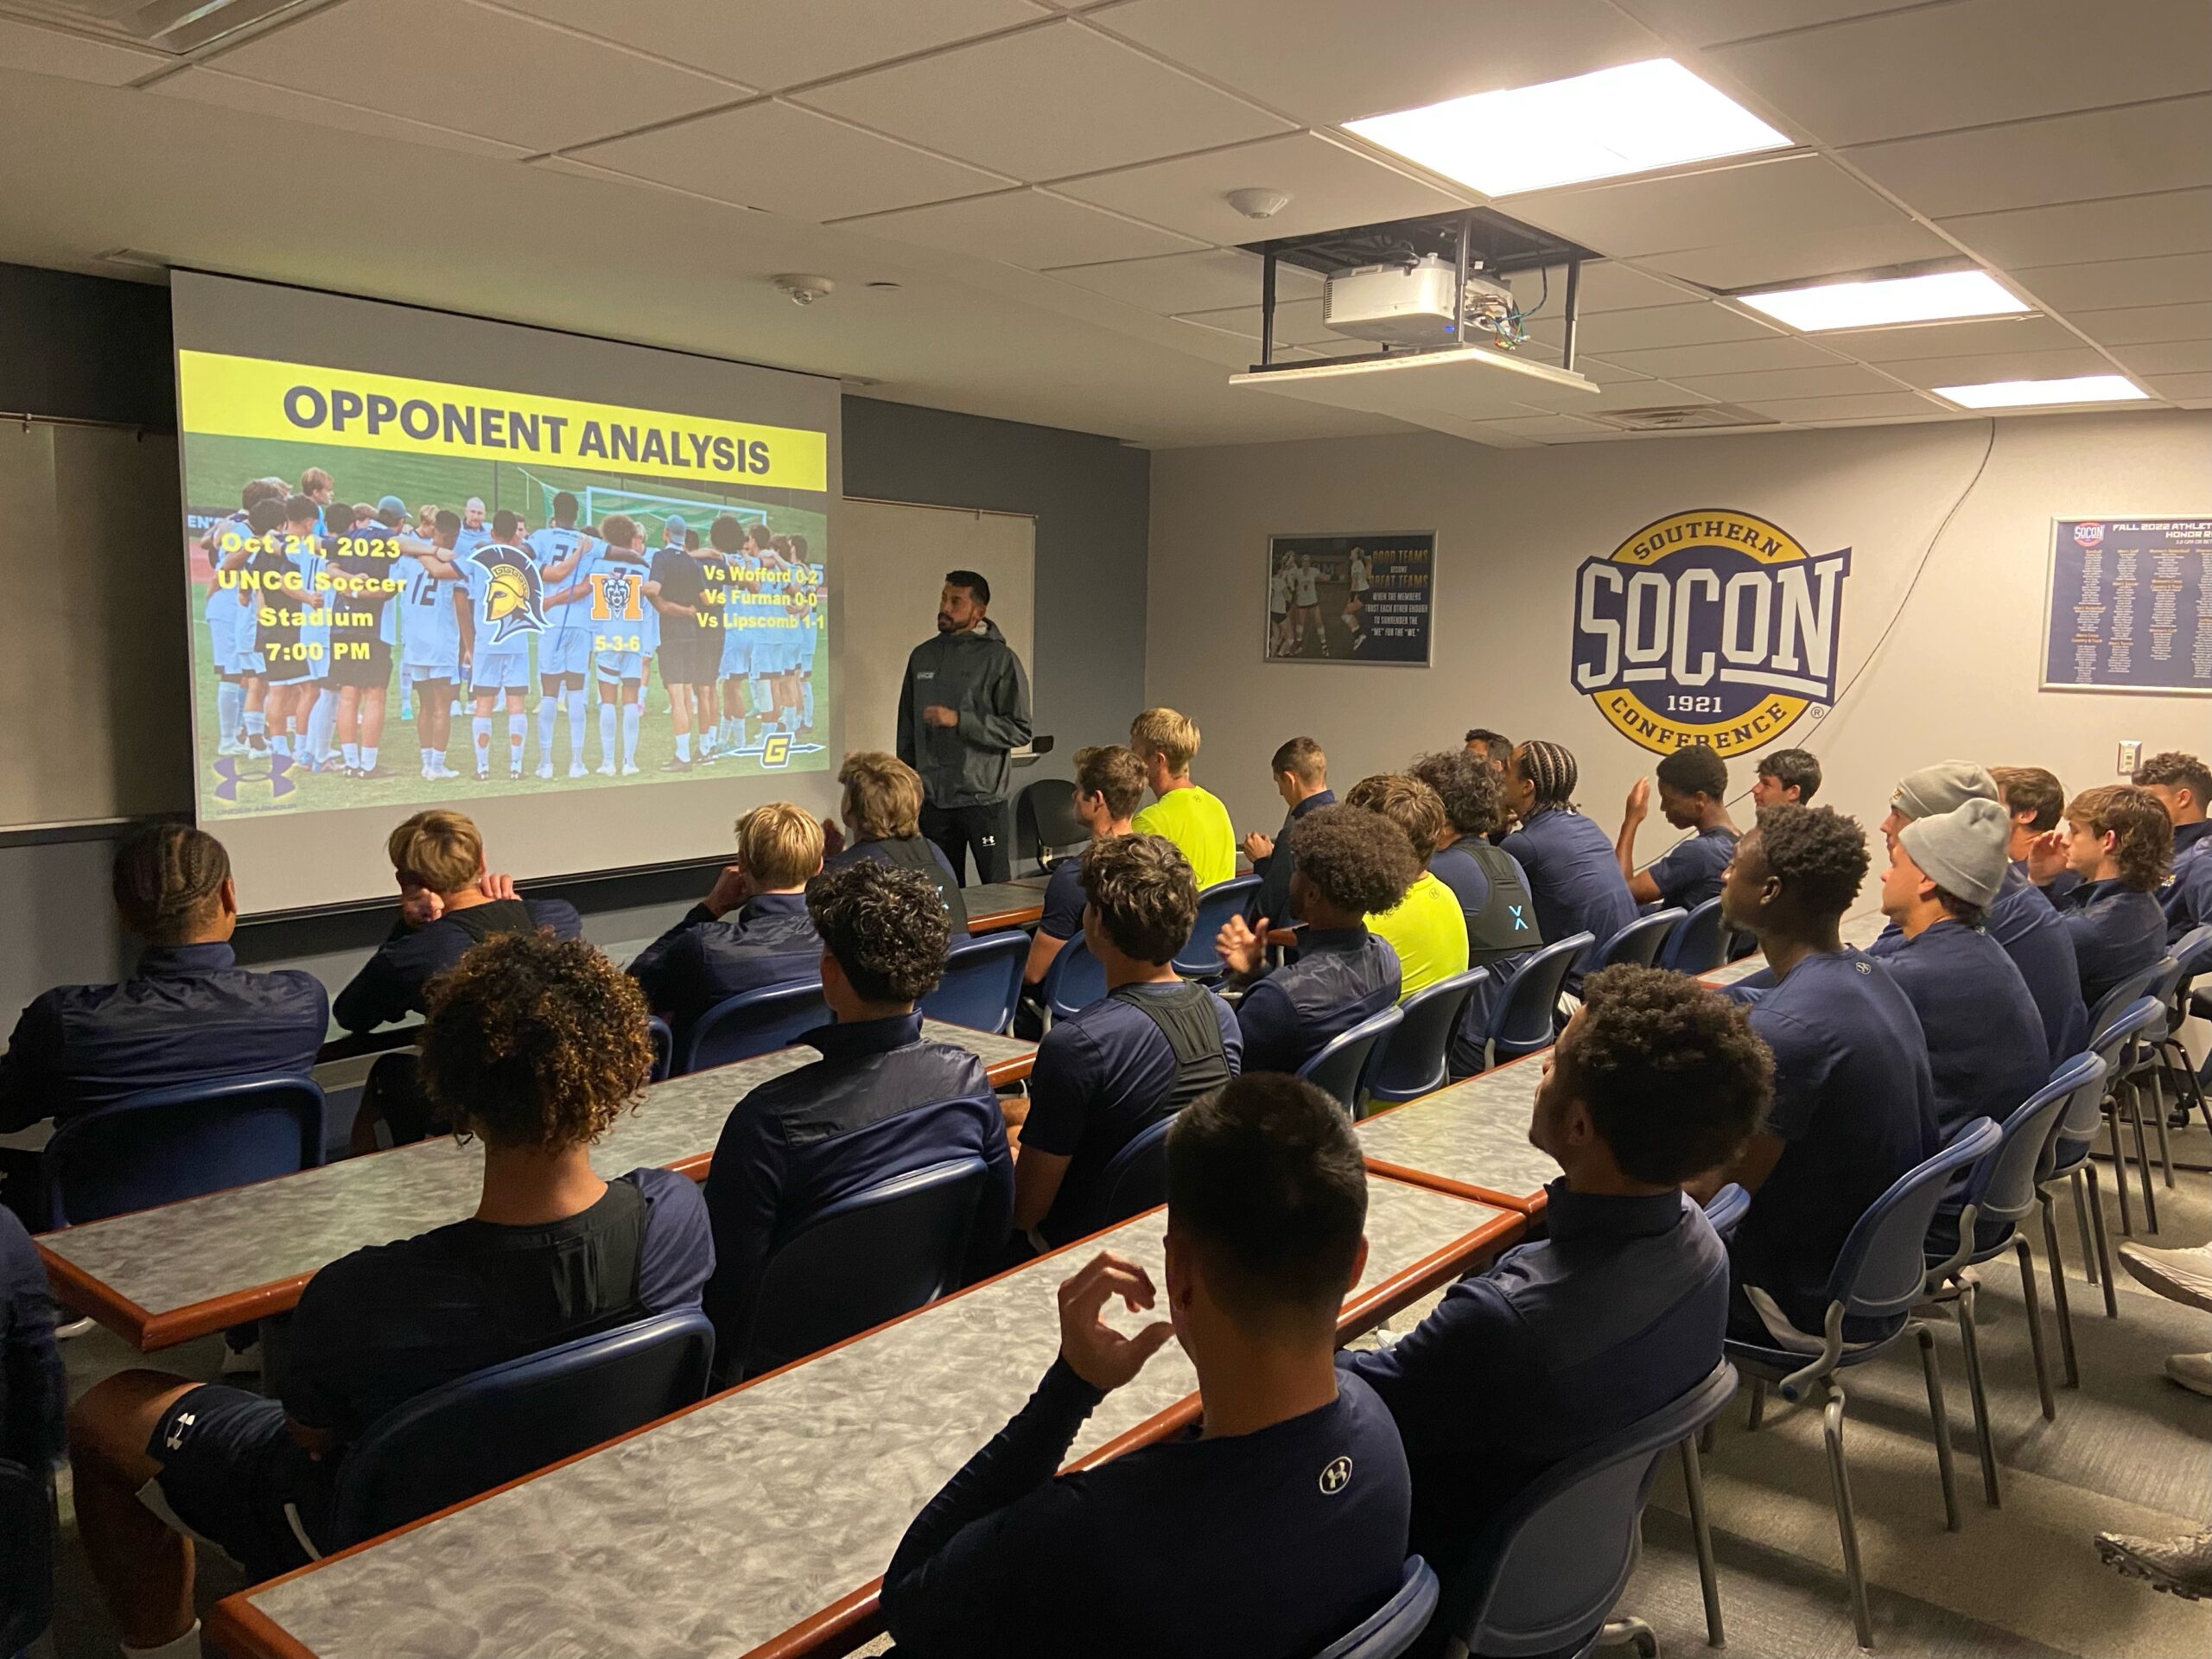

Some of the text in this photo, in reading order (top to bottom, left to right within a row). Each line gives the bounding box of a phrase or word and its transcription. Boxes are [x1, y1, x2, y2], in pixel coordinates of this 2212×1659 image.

[283, 385, 771, 474] OPPONENT ANALYSIS
[1633, 521, 1783, 560] SOUTHERN
[2075, 524, 2105, 540] SOCON
[221, 532, 401, 558] Oct 21, 2023
[1398, 550, 1428, 562] TEAMS
[218, 569, 302, 590] UNCG
[315, 572, 407, 592] Soccer
[703, 564, 818, 584] Vs Wofford 0-2
[1399, 575, 1428, 588] TEAMS
[704, 588, 817, 607] Vs Furman 0-0
[1397, 592, 1421, 601] MEMBERS
[259, 607, 373, 626] Stadium
[1380, 604, 1392, 613] EACH
[696, 612, 824, 631] Vs Lipscomb 1-1
[1577, 558, 1844, 690] SOCON
[265, 643, 371, 661] 7:00 PM
[594, 635, 640, 652] 5-3-6
[1667, 696, 1722, 713] 1921
[1611, 696, 1787, 749] CONFERENCE
